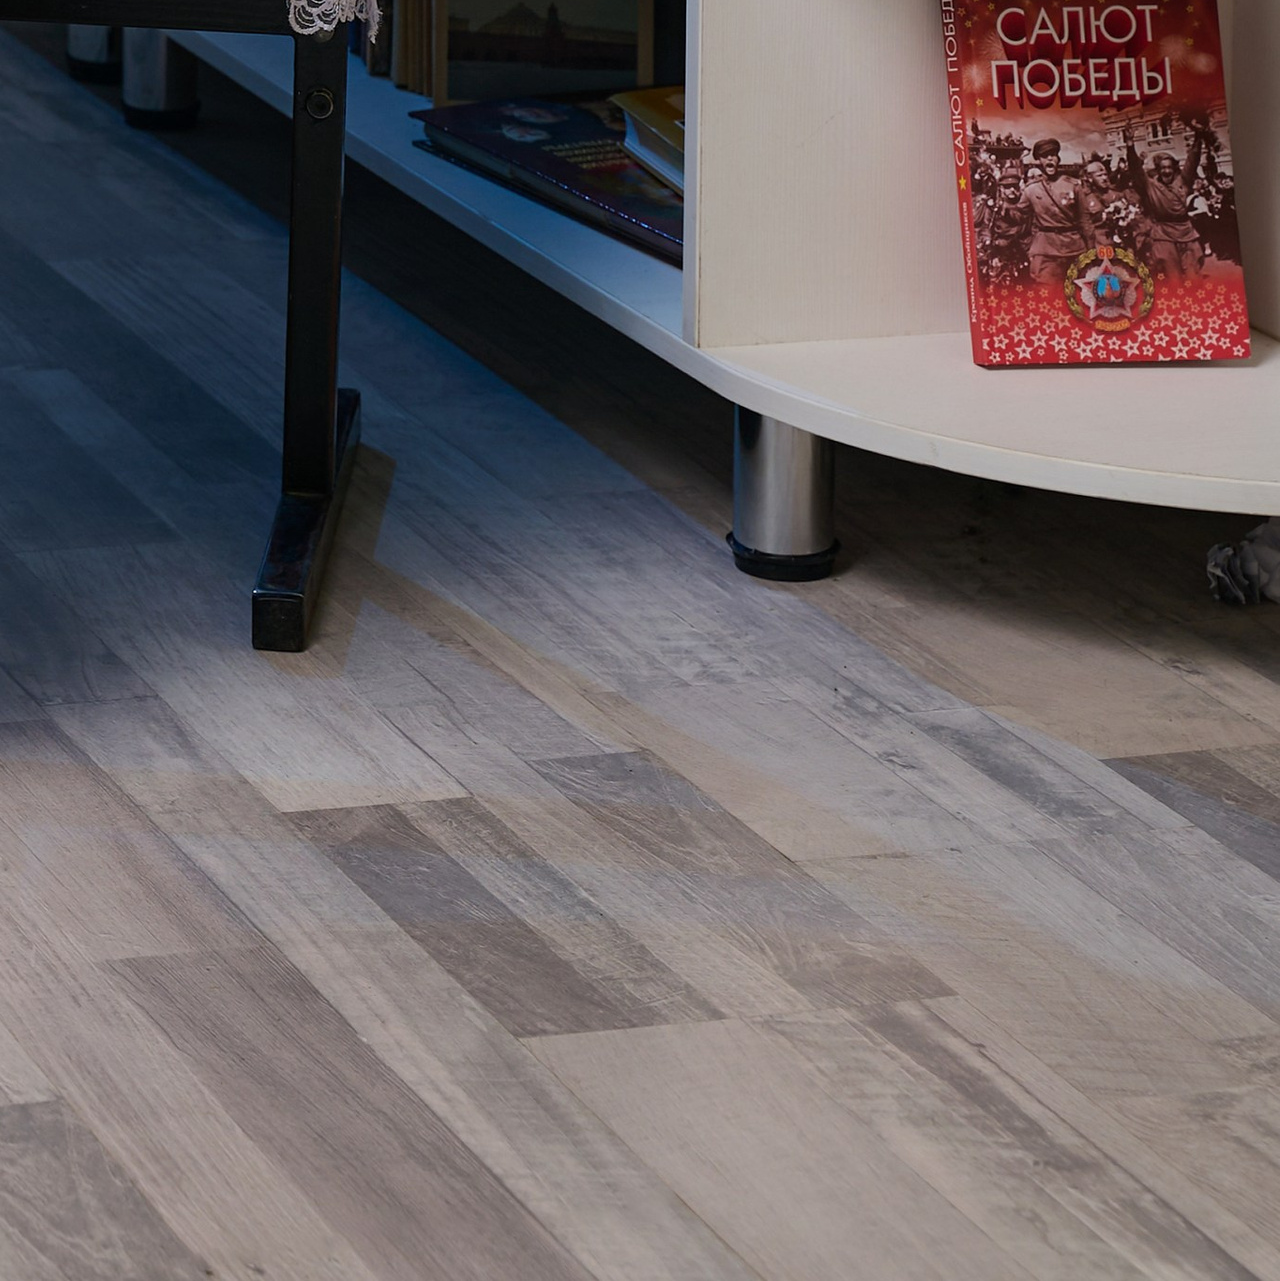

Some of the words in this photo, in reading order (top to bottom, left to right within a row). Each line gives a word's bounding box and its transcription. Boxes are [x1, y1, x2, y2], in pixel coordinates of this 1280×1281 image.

[996, 5, 1159, 46] САЛЮТ
[990, 56, 1173, 102] ПОБЕДЫ
[949, 84, 967, 167] САЛЮТ
